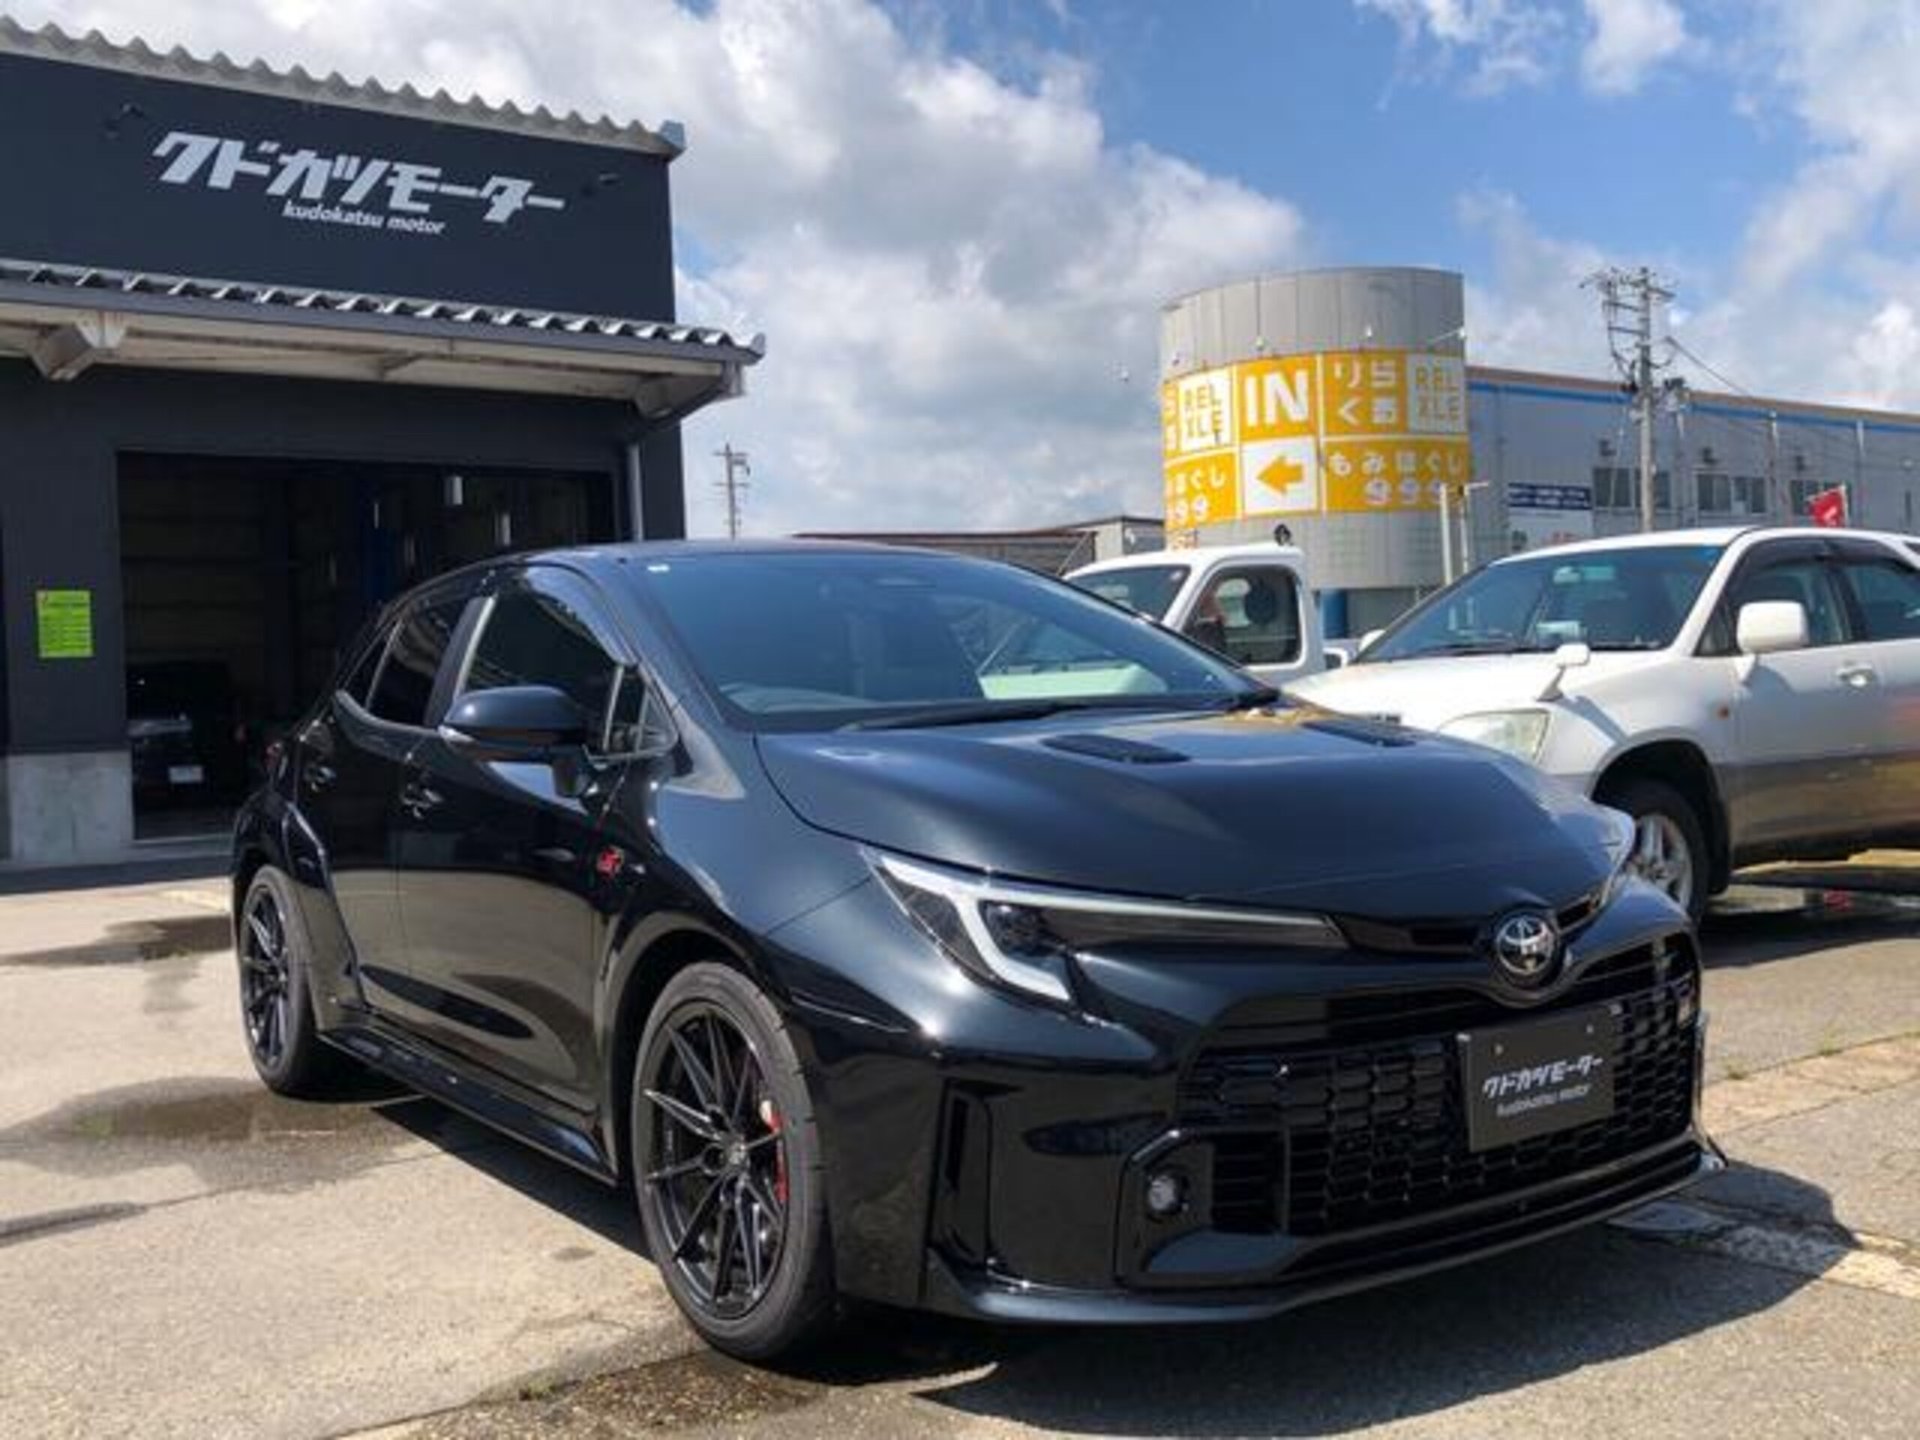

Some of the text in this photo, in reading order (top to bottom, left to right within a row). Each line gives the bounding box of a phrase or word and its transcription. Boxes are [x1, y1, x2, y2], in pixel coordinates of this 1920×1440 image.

[153, 131, 566, 224] クドカツモーター
[283, 199, 447, 236] kudokatsu motor
[1243, 368, 1309, 426] IN
